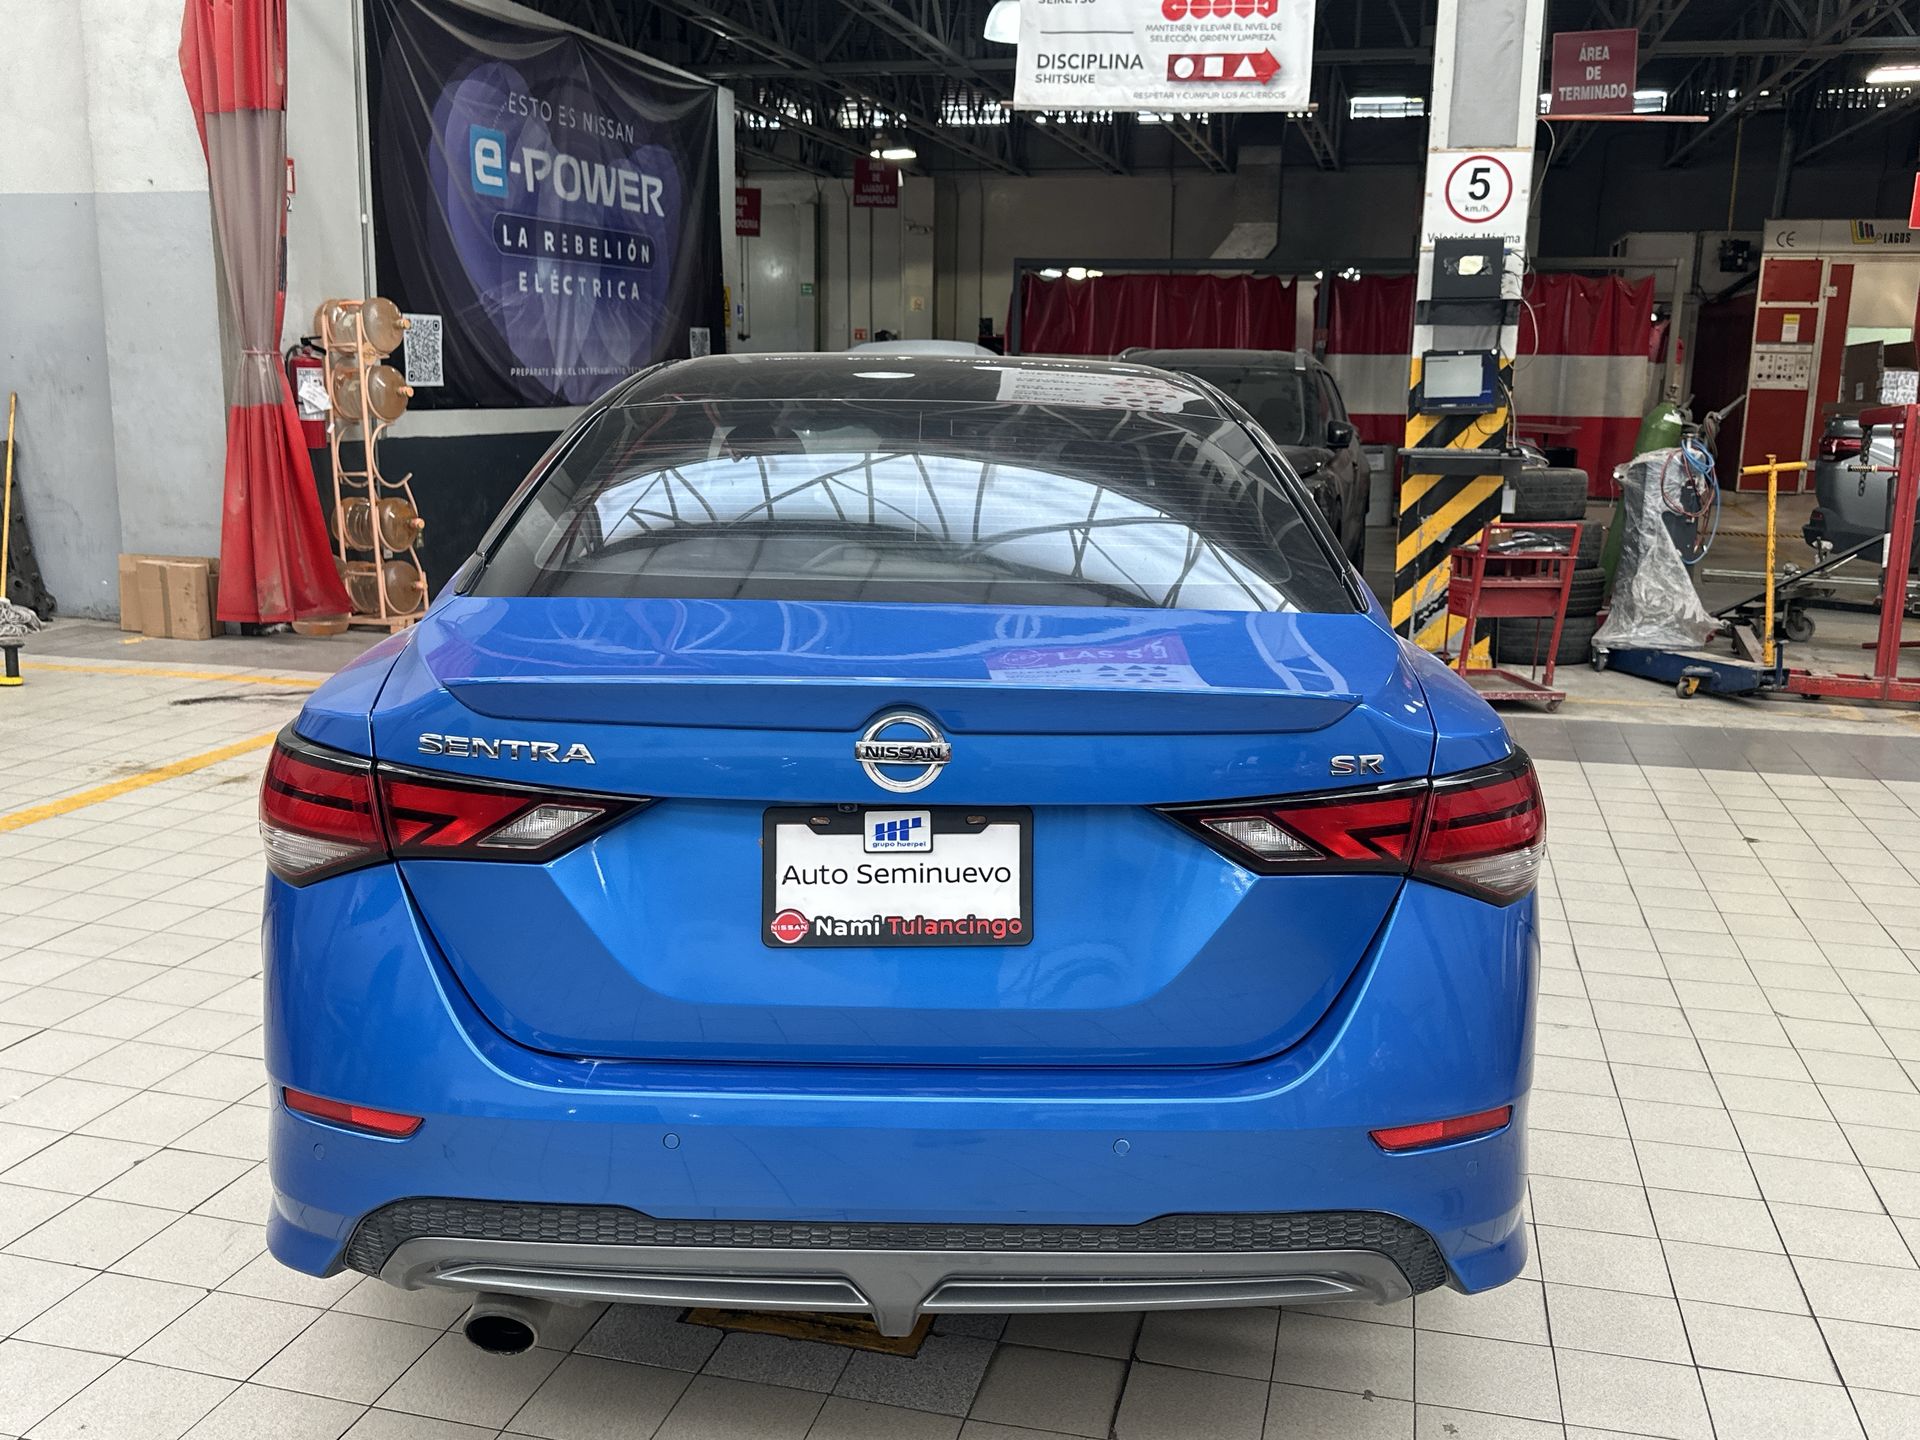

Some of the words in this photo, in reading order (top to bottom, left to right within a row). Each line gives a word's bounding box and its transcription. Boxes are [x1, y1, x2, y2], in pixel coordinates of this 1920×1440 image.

[1145, 23, 1192, 32] MANTENER
[1194, 24, 1199, 32] Y
[1200, 23, 1231, 32] ELEVAR
[1233, 23, 1243, 31] EL
[1245, 23, 1269, 31] NIVEL
[1271, 22, 1282, 31] DE
[1200, 34, 1229, 42] ORDEN
[1231, 34, 1237, 42] Y
[1578, 42, 1610, 62] ÁREA
[1036, 53, 1144, 70] DISCIPLINA
[1035, 73, 1096, 84] SHITSUKE
[1585, 66, 1601, 80] DE
[1133, 91, 1174, 100] RESPETAR
[1176, 91, 1181, 99] Y
[1183, 91, 1219, 99] CUMPLIR
[1222, 91, 1237, 99] LOS
[1558, 83, 1627, 101] TERMINADO
[507, 91, 552, 122] ESTO
[558, 104, 577, 129] ES
[582, 112, 635, 144] NISSAN
[1468, 167, 1491, 201] 5
[502, 224, 528, 249] LA
[544, 230, 651, 264] REBELIÓN
[1883, 232, 1911, 244] LAGOS
[518, 268, 641, 301] ELÉCTRICA
[418, 733, 596, 765] SENTRA
[864, 745, 941, 761] NISSAN
[1330, 754, 1386, 776] SR
[872, 841, 895, 849] grupo
[896, 840, 926, 848] huerpel
[781, 865, 848, 885] Auto
[857, 863, 1011, 884] Seminuevo
[770, 923, 809, 932] NISSAN
[815, 917, 880, 937] Nami
[888, 916, 1023, 940] Tulancingo
